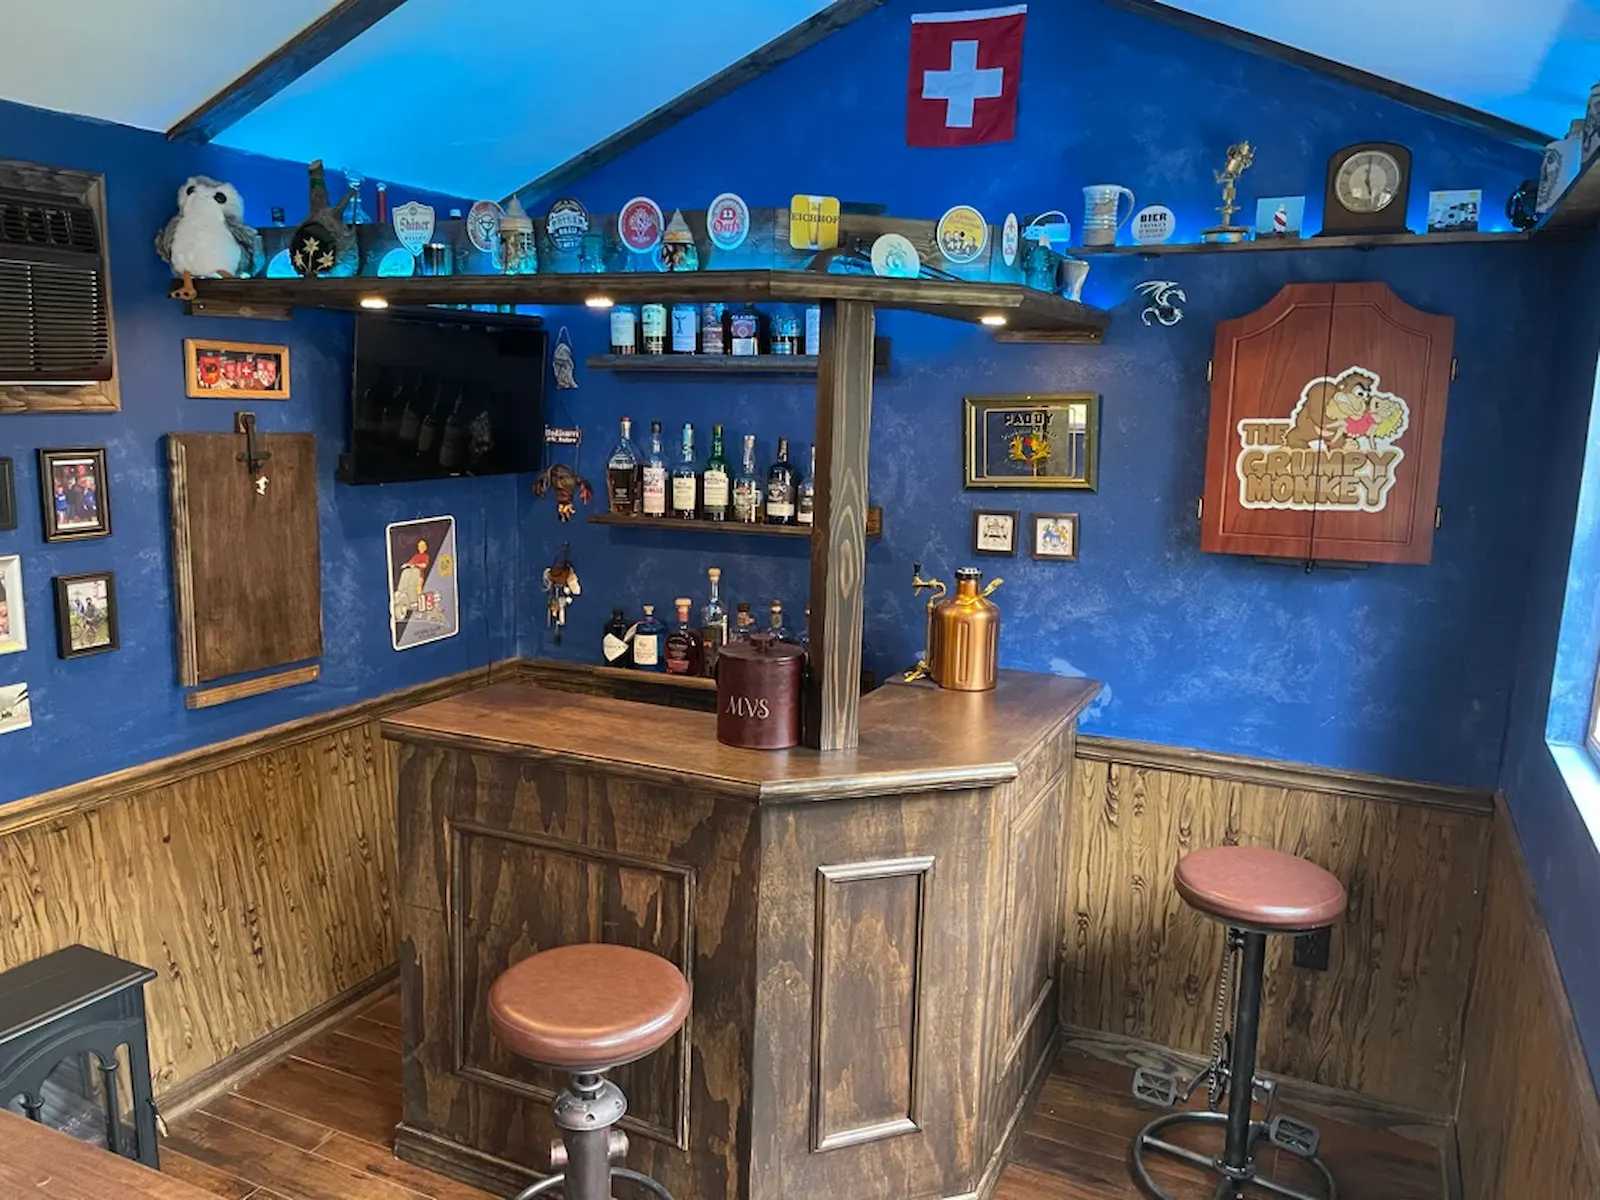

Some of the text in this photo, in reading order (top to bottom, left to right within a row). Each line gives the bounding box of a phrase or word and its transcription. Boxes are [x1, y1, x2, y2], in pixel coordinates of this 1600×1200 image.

[791, 212, 840, 225] EICHHOF
[1004, 413, 1054, 427] PADDY
[1242, 423, 1289, 446] THE
[1241, 450, 1398, 476] GRUMPY
[1245, 474, 1389, 506] MONKEY
[725, 696, 770, 719] MVS
